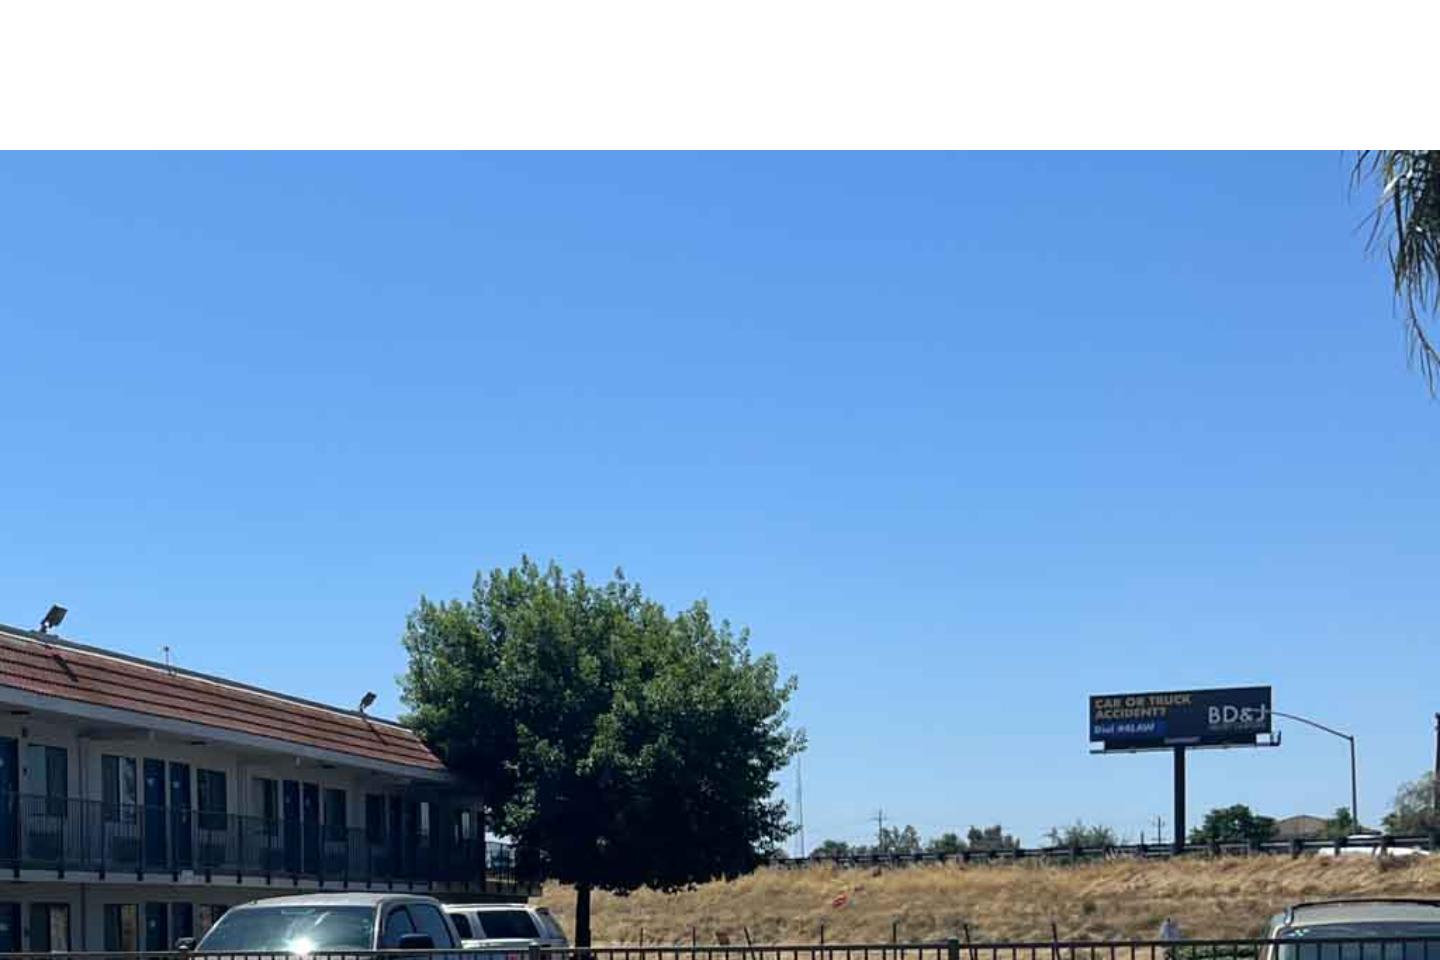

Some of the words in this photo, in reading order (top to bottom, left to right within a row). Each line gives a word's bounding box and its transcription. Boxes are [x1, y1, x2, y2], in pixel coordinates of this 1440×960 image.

[1094, 698, 1121, 709] CAR
[1125, 696, 1145, 707] OR
[1146, 694, 1192, 705] TRUCK
[1208, 703, 1266, 724] BD&J
